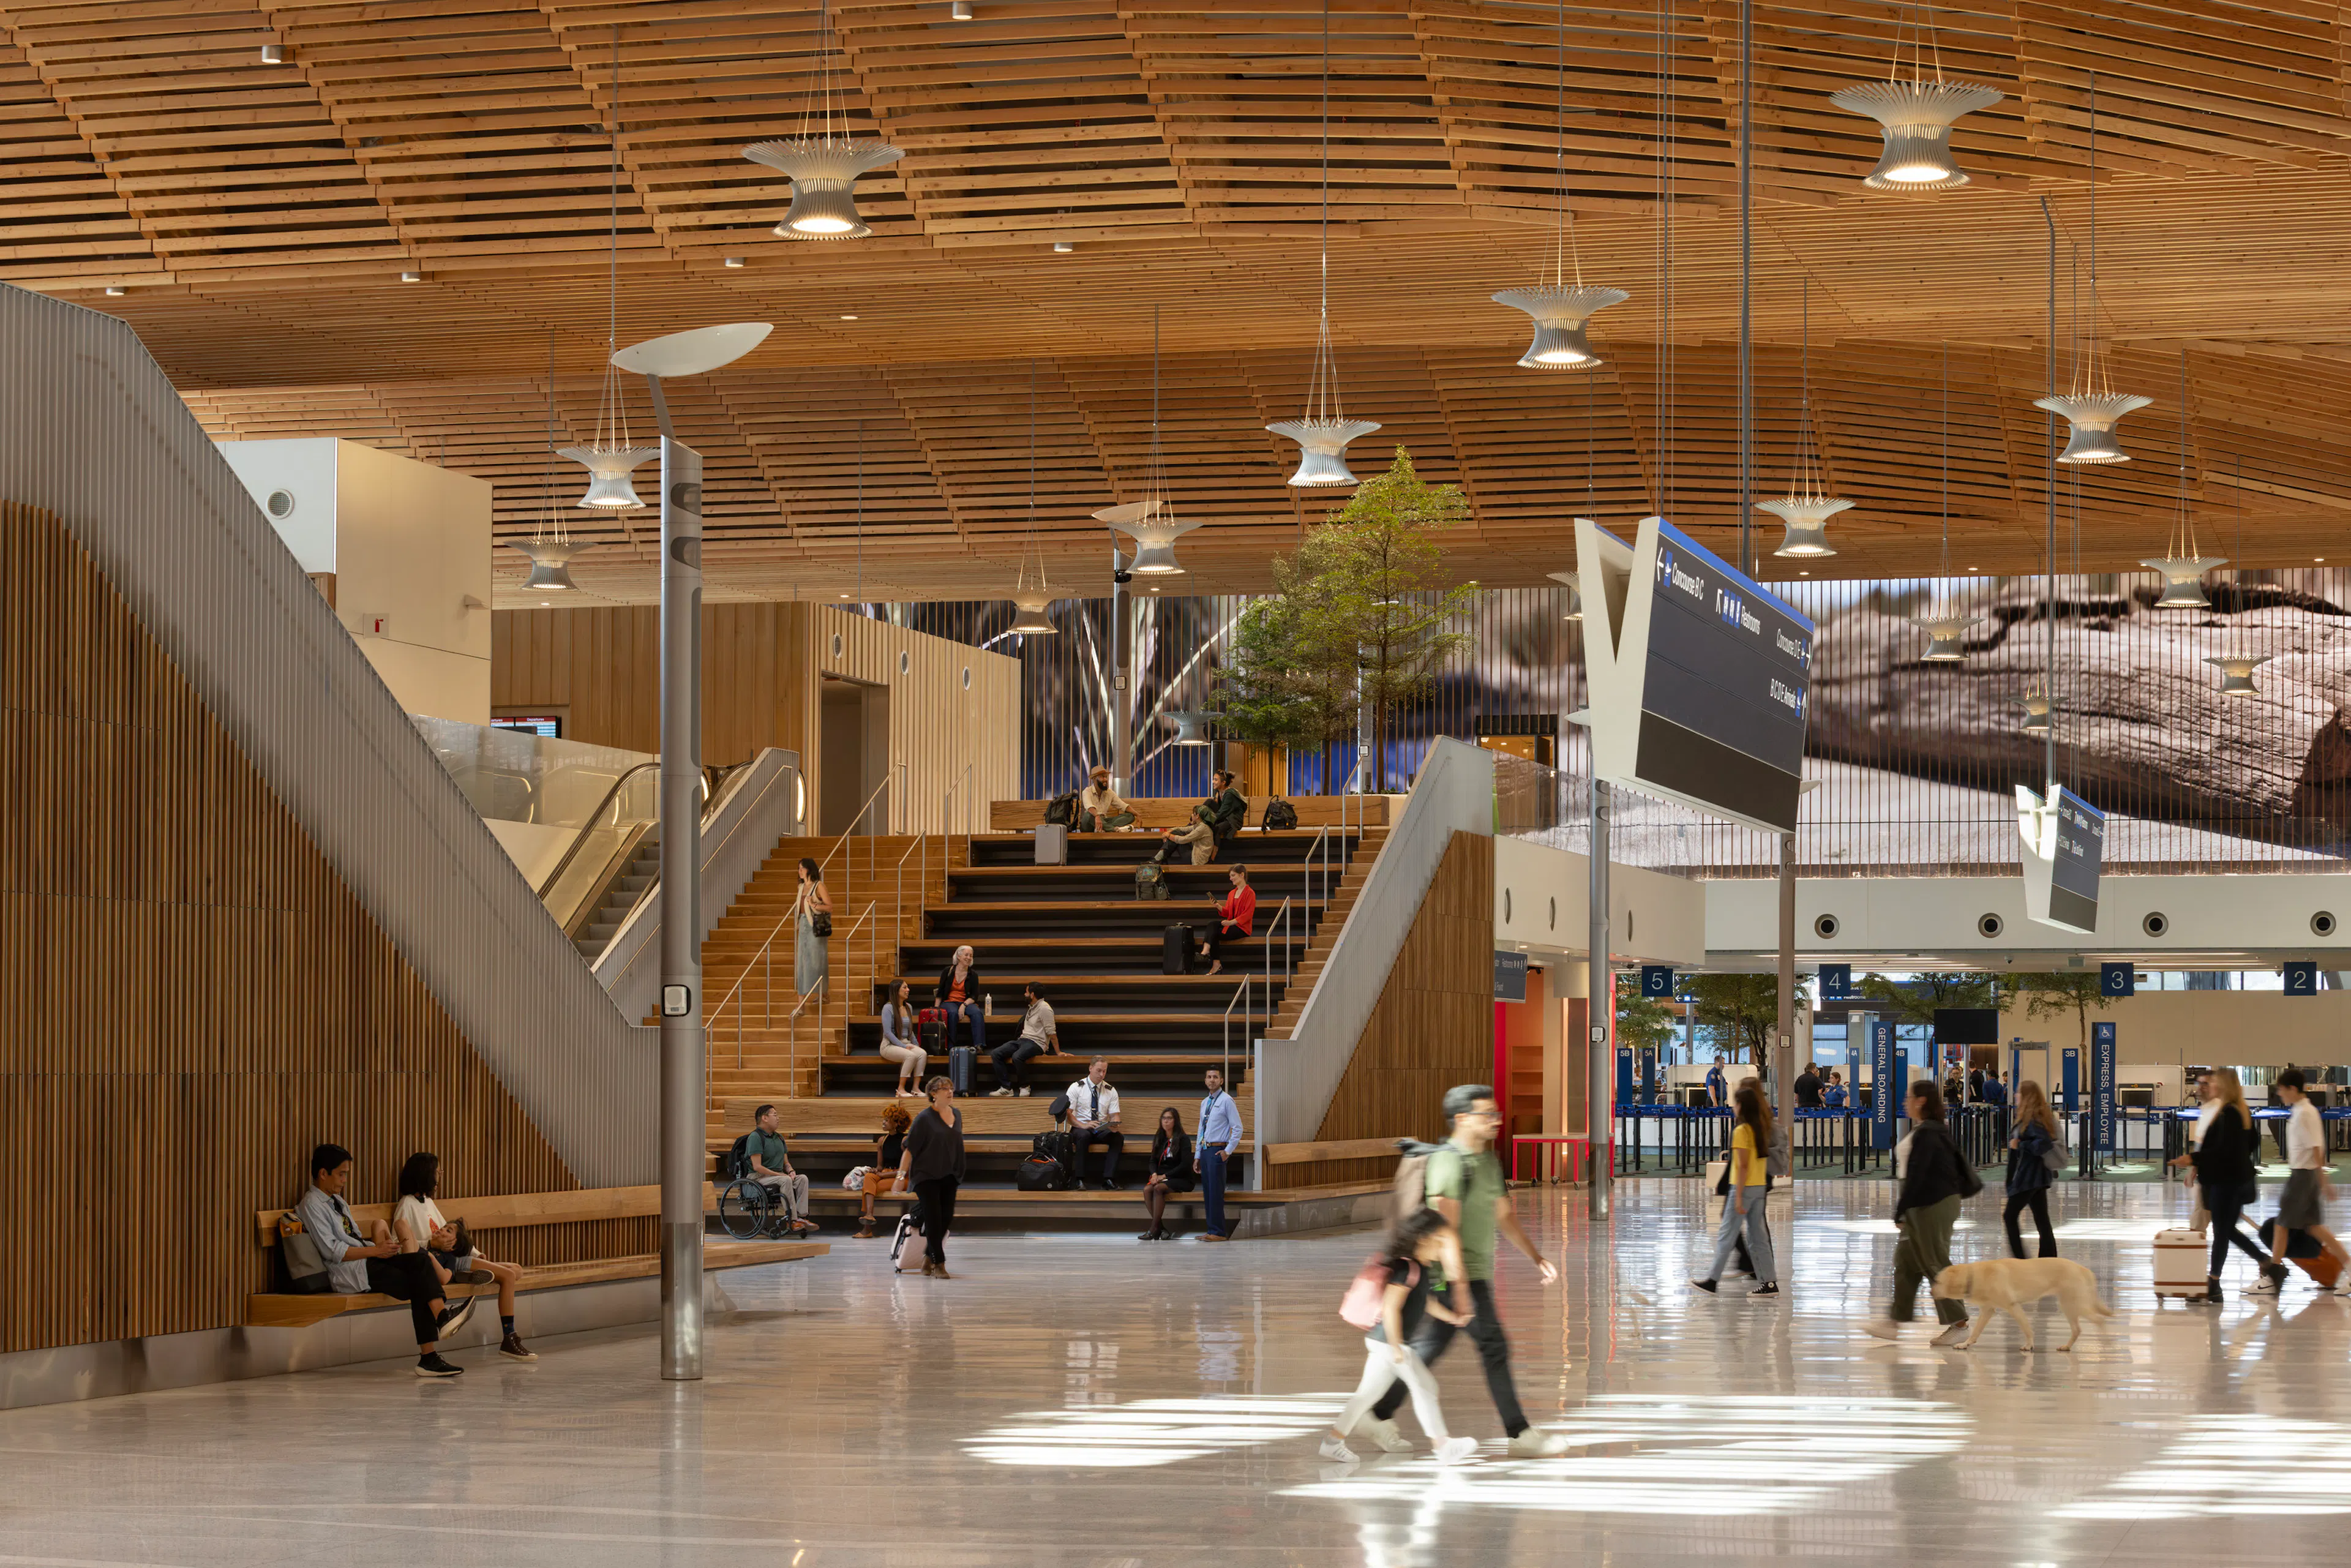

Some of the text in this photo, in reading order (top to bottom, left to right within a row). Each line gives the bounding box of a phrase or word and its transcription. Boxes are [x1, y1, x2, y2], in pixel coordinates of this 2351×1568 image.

[1672, 562, 1704, 600] Concourse B C
[1741, 606, 1761, 635] Restrooms
[1777, 628, 1801, 659] Concourse D E
[1769, 678, 1775, 697] B
[1774, 680, 1779, 699] C
[1777, 682, 1782, 700] D
[1780, 684, 1785, 703] E
[1651, 972, 1663, 990] 5
[1828, 972, 1841, 990] 4
[2112, 971, 2124, 989] 3
[2294, 970, 2306, 989] 2
[1878, 1027, 1886, 1123] GENERAL BOARDING
[2099, 1045, 2110, 1145] EXPRESS, EMPLOYEE
